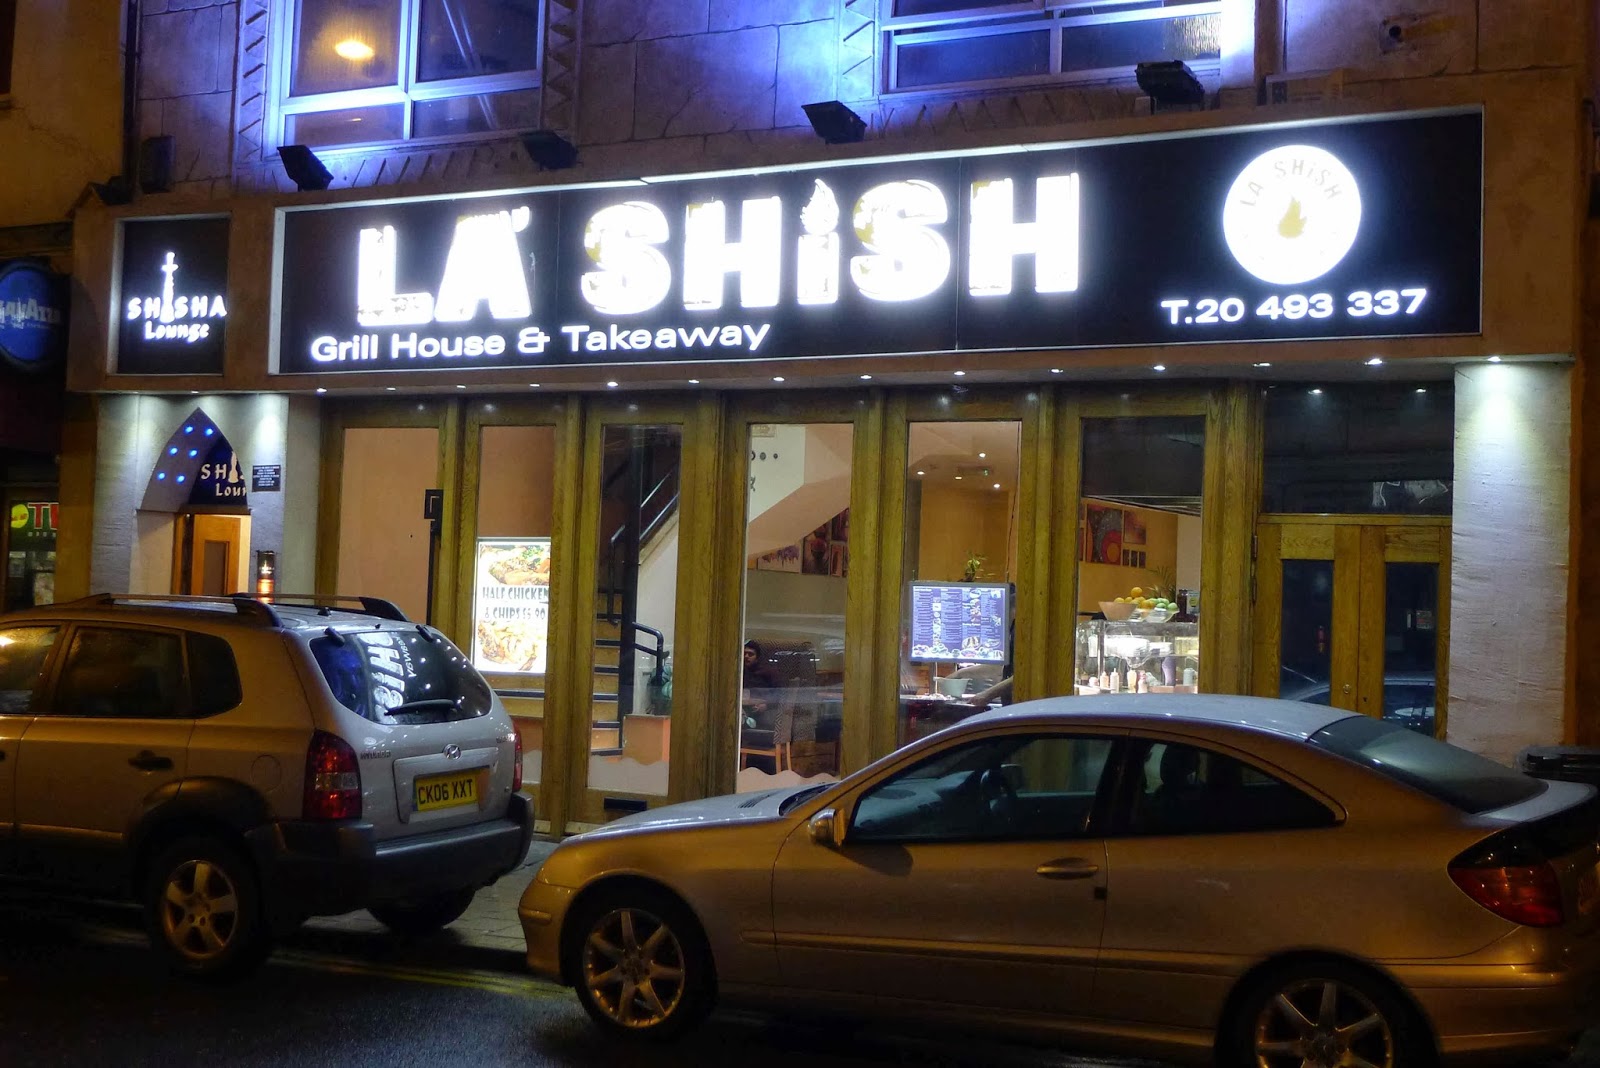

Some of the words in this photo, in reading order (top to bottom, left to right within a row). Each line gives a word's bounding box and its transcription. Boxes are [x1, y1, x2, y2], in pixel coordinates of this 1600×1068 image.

[1256, 293, 1333, 320] 493
[1347, 288, 1427, 317] 337
[144, 320, 210, 343] Lounge
[310, 333, 378, 362] Grill
[391, 331, 506, 358] House
[518, 327, 550, 354] &
[561, 323, 770, 352] Takeaway
[482, 586, 505, 599] HALF
[493, 607, 520, 619] CHIPS
[418, 784, 449, 805] CK06
[452, 778, 473, 800] XXT
